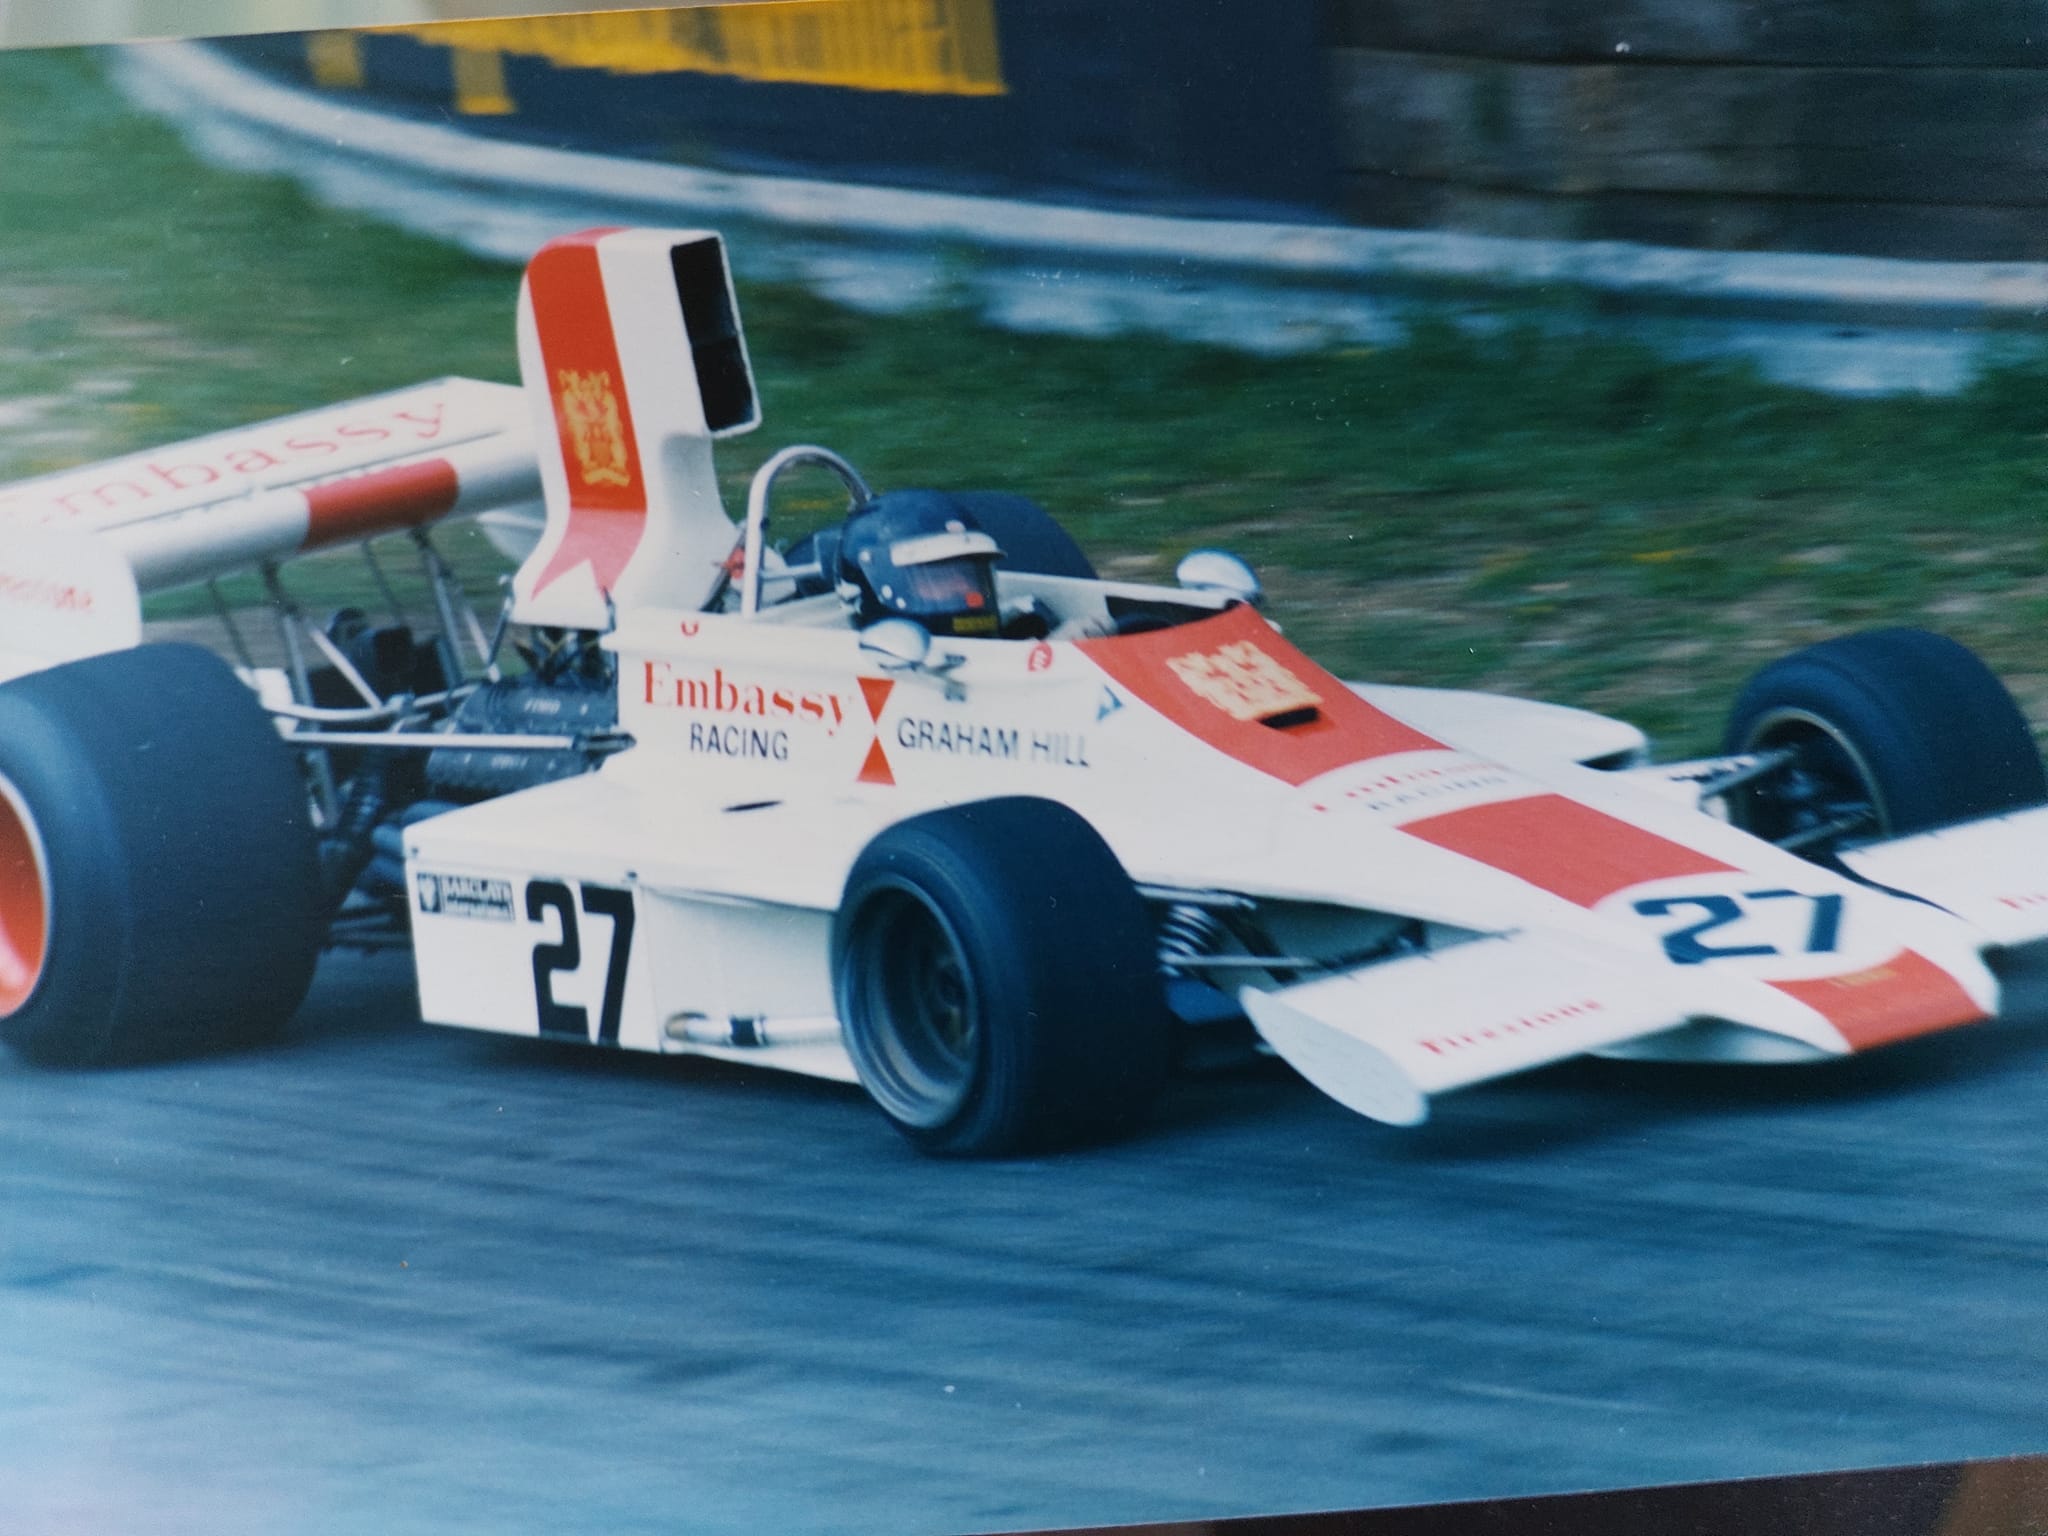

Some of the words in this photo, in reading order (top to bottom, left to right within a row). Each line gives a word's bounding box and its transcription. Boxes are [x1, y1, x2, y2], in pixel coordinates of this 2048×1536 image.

[0, 402, 446, 527] mbassy
[643, 660, 852, 738] Embassy
[689, 722, 790, 762] RACING
[898, 718, 1020, 760] GRAHAM
[1031, 730, 1091, 769] HILL
[525, 879, 636, 1047] 27
[1633, 888, 1843, 965] 27
